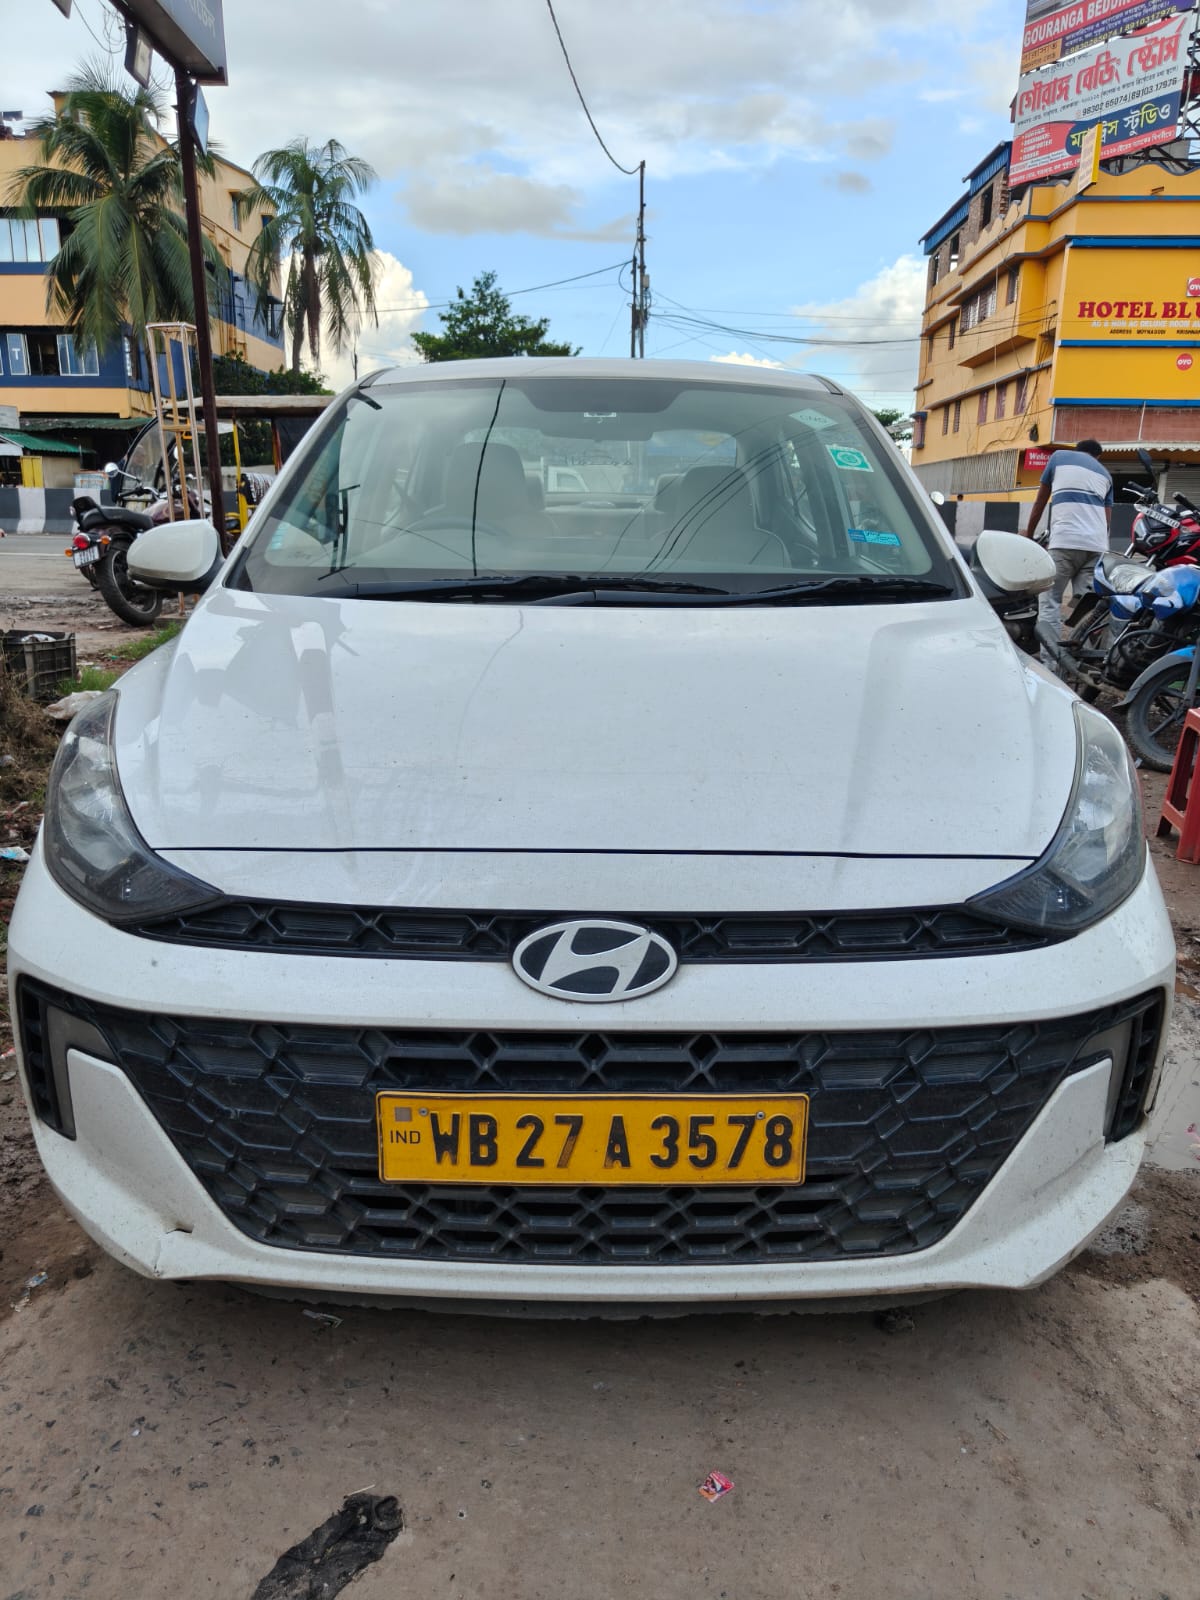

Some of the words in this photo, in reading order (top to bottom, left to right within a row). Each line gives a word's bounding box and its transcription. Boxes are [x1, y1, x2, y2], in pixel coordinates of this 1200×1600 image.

[1024, 8, 1083, 47] GOURANGA
[1018, 74, 1072, 116] গৌরাঙ্গ
[1076, 51, 1120, 94] বেডিং
[1122, 103, 1171, 136] স্টুডিও
[1078, 301, 1157, 318] HOTEL
[1177, 357, 1192, 365] OYO
[390, 1130, 421, 1144] IND
[430, 1112, 498, 1167] WB
[516, 1114, 584, 1168] 27
[603, 1114, 631, 1168] A
[650, 1114, 794, 1168] 3578
